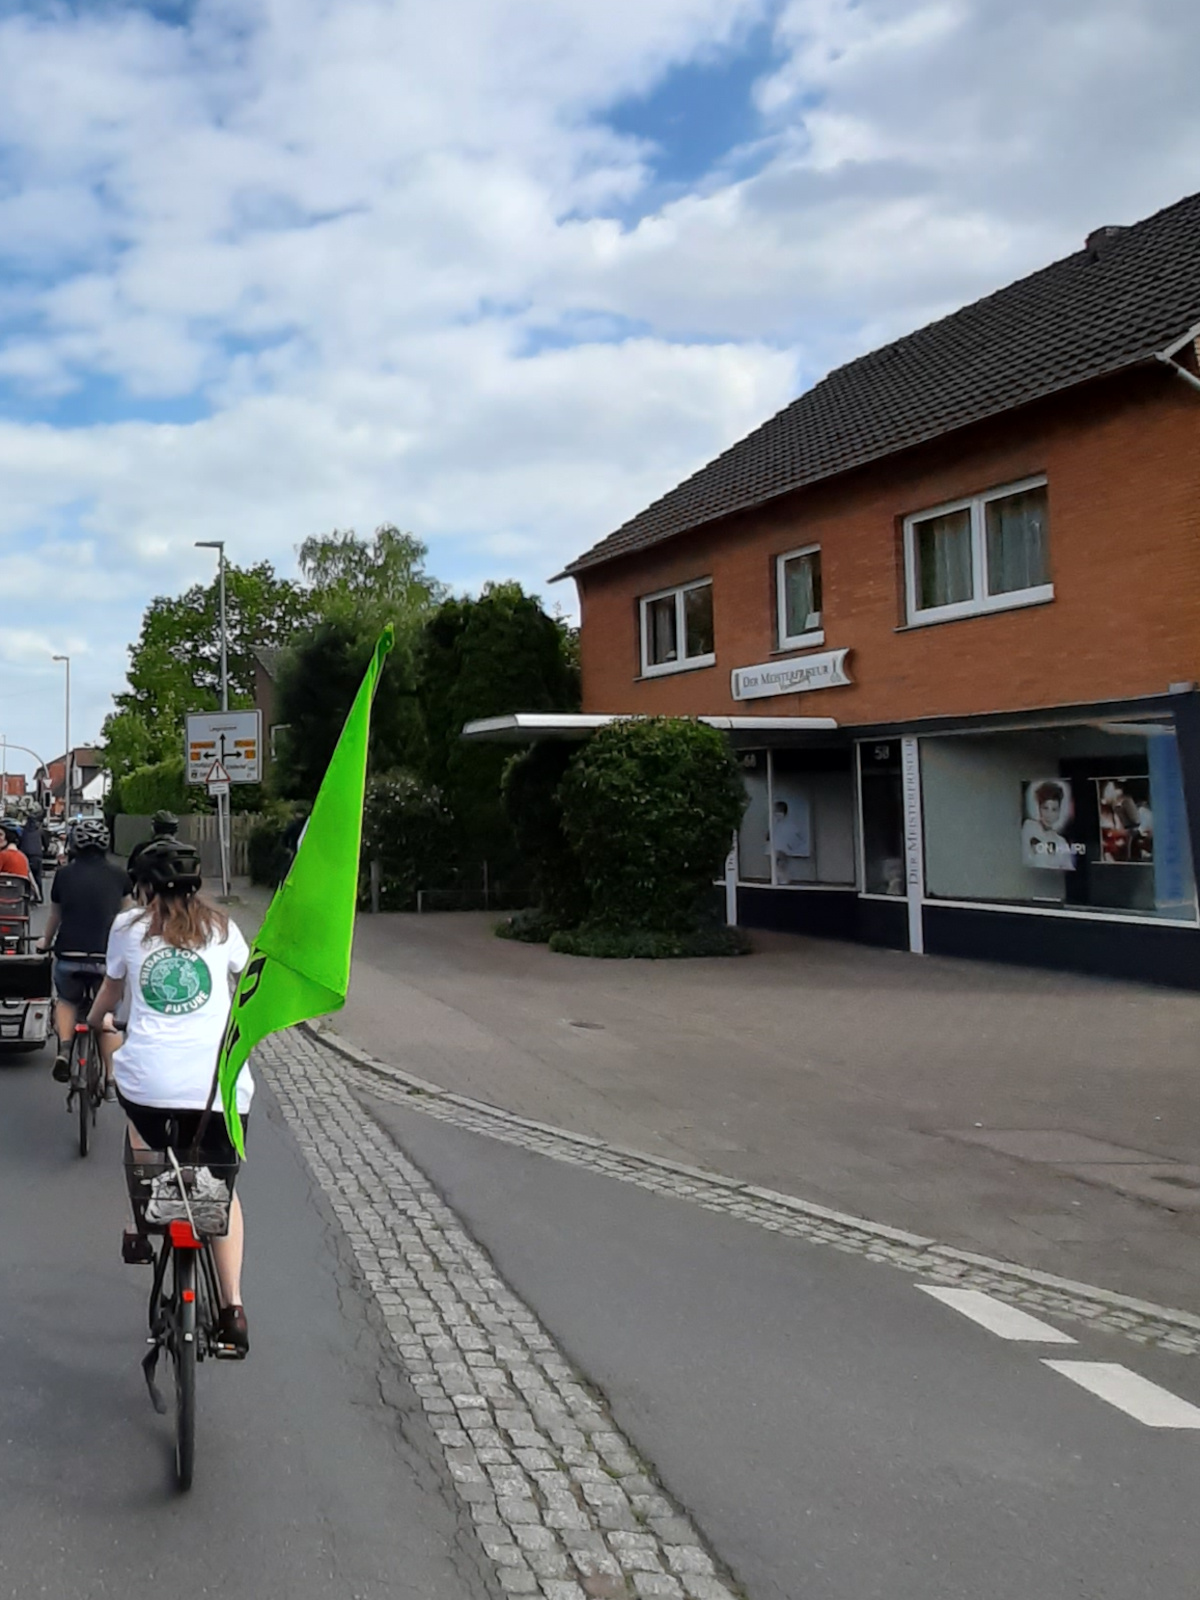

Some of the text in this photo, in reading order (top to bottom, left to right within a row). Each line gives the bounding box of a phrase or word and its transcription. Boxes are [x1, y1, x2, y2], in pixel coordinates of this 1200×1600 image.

[141, 948, 198, 986] FRIDAYS FOR
[165, 990, 208, 1014] FUTURE
